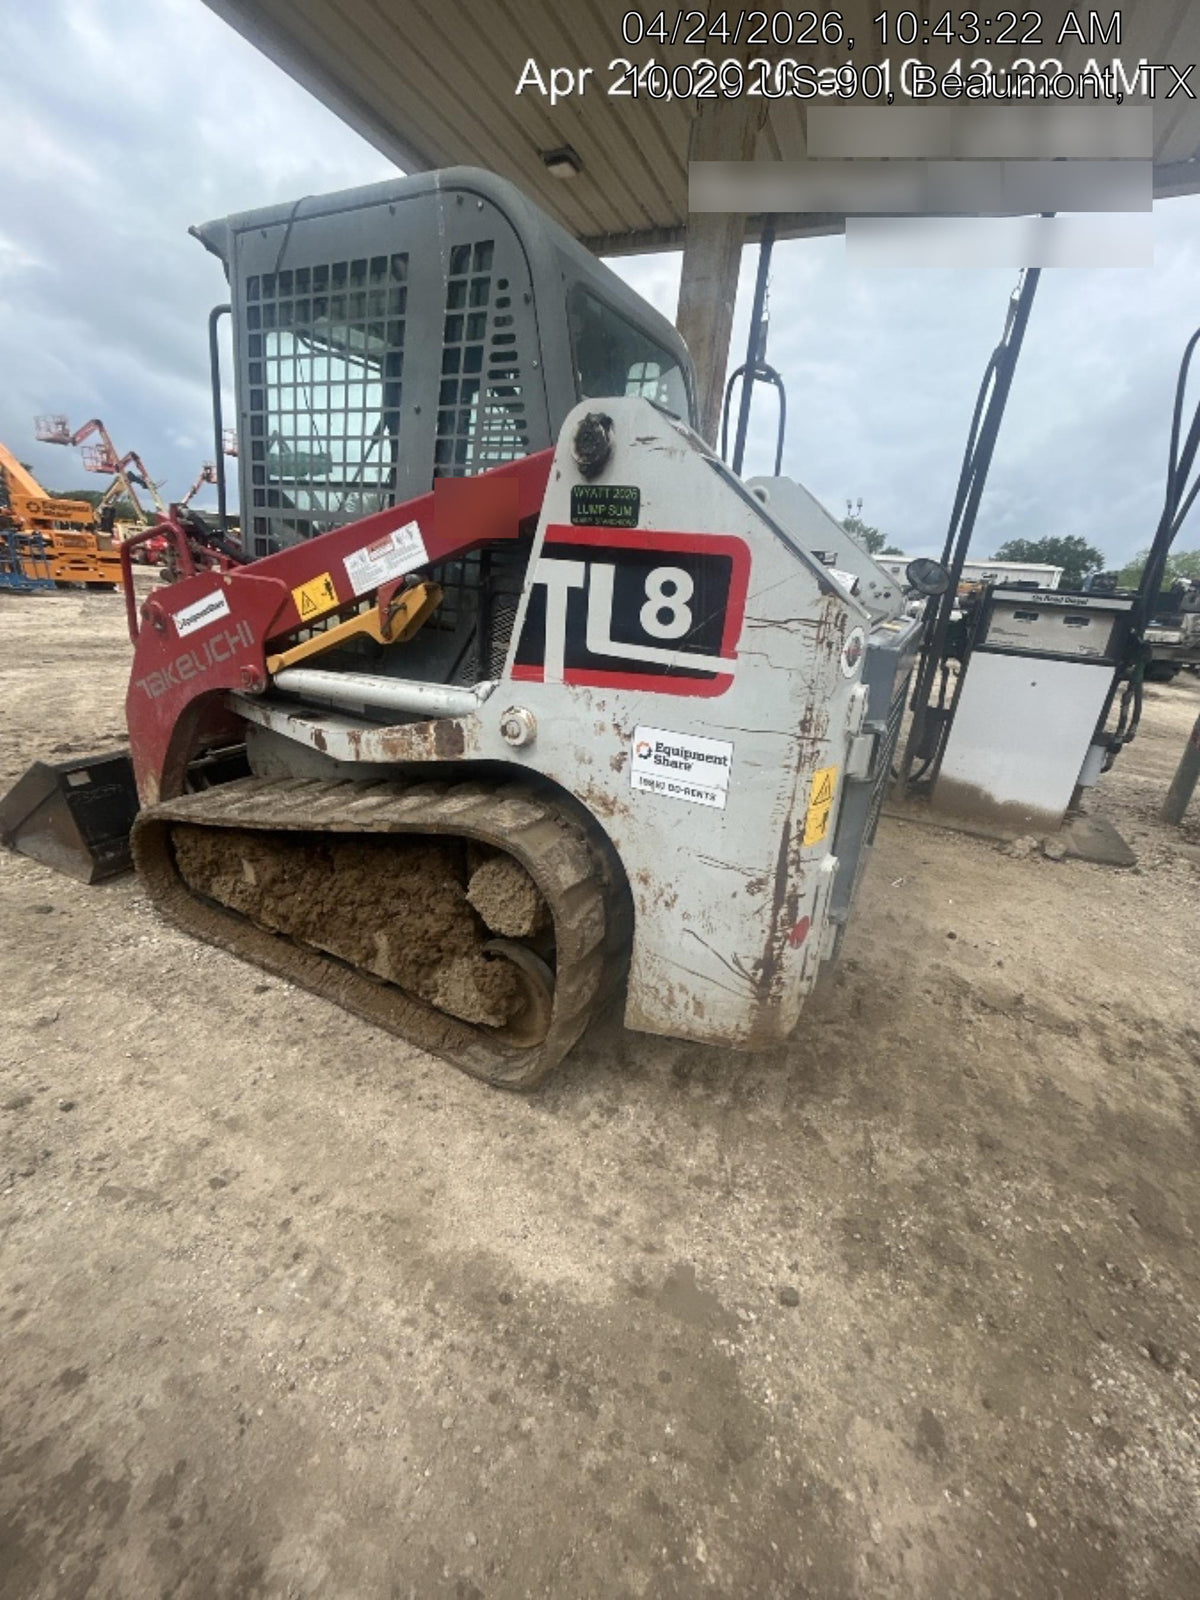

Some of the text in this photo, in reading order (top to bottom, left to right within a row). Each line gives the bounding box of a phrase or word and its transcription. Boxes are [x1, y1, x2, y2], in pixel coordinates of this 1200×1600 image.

[531, 557, 738, 684] TL8
[653, 753, 693, 771] Share
[655, 741, 728, 767] Equipment
